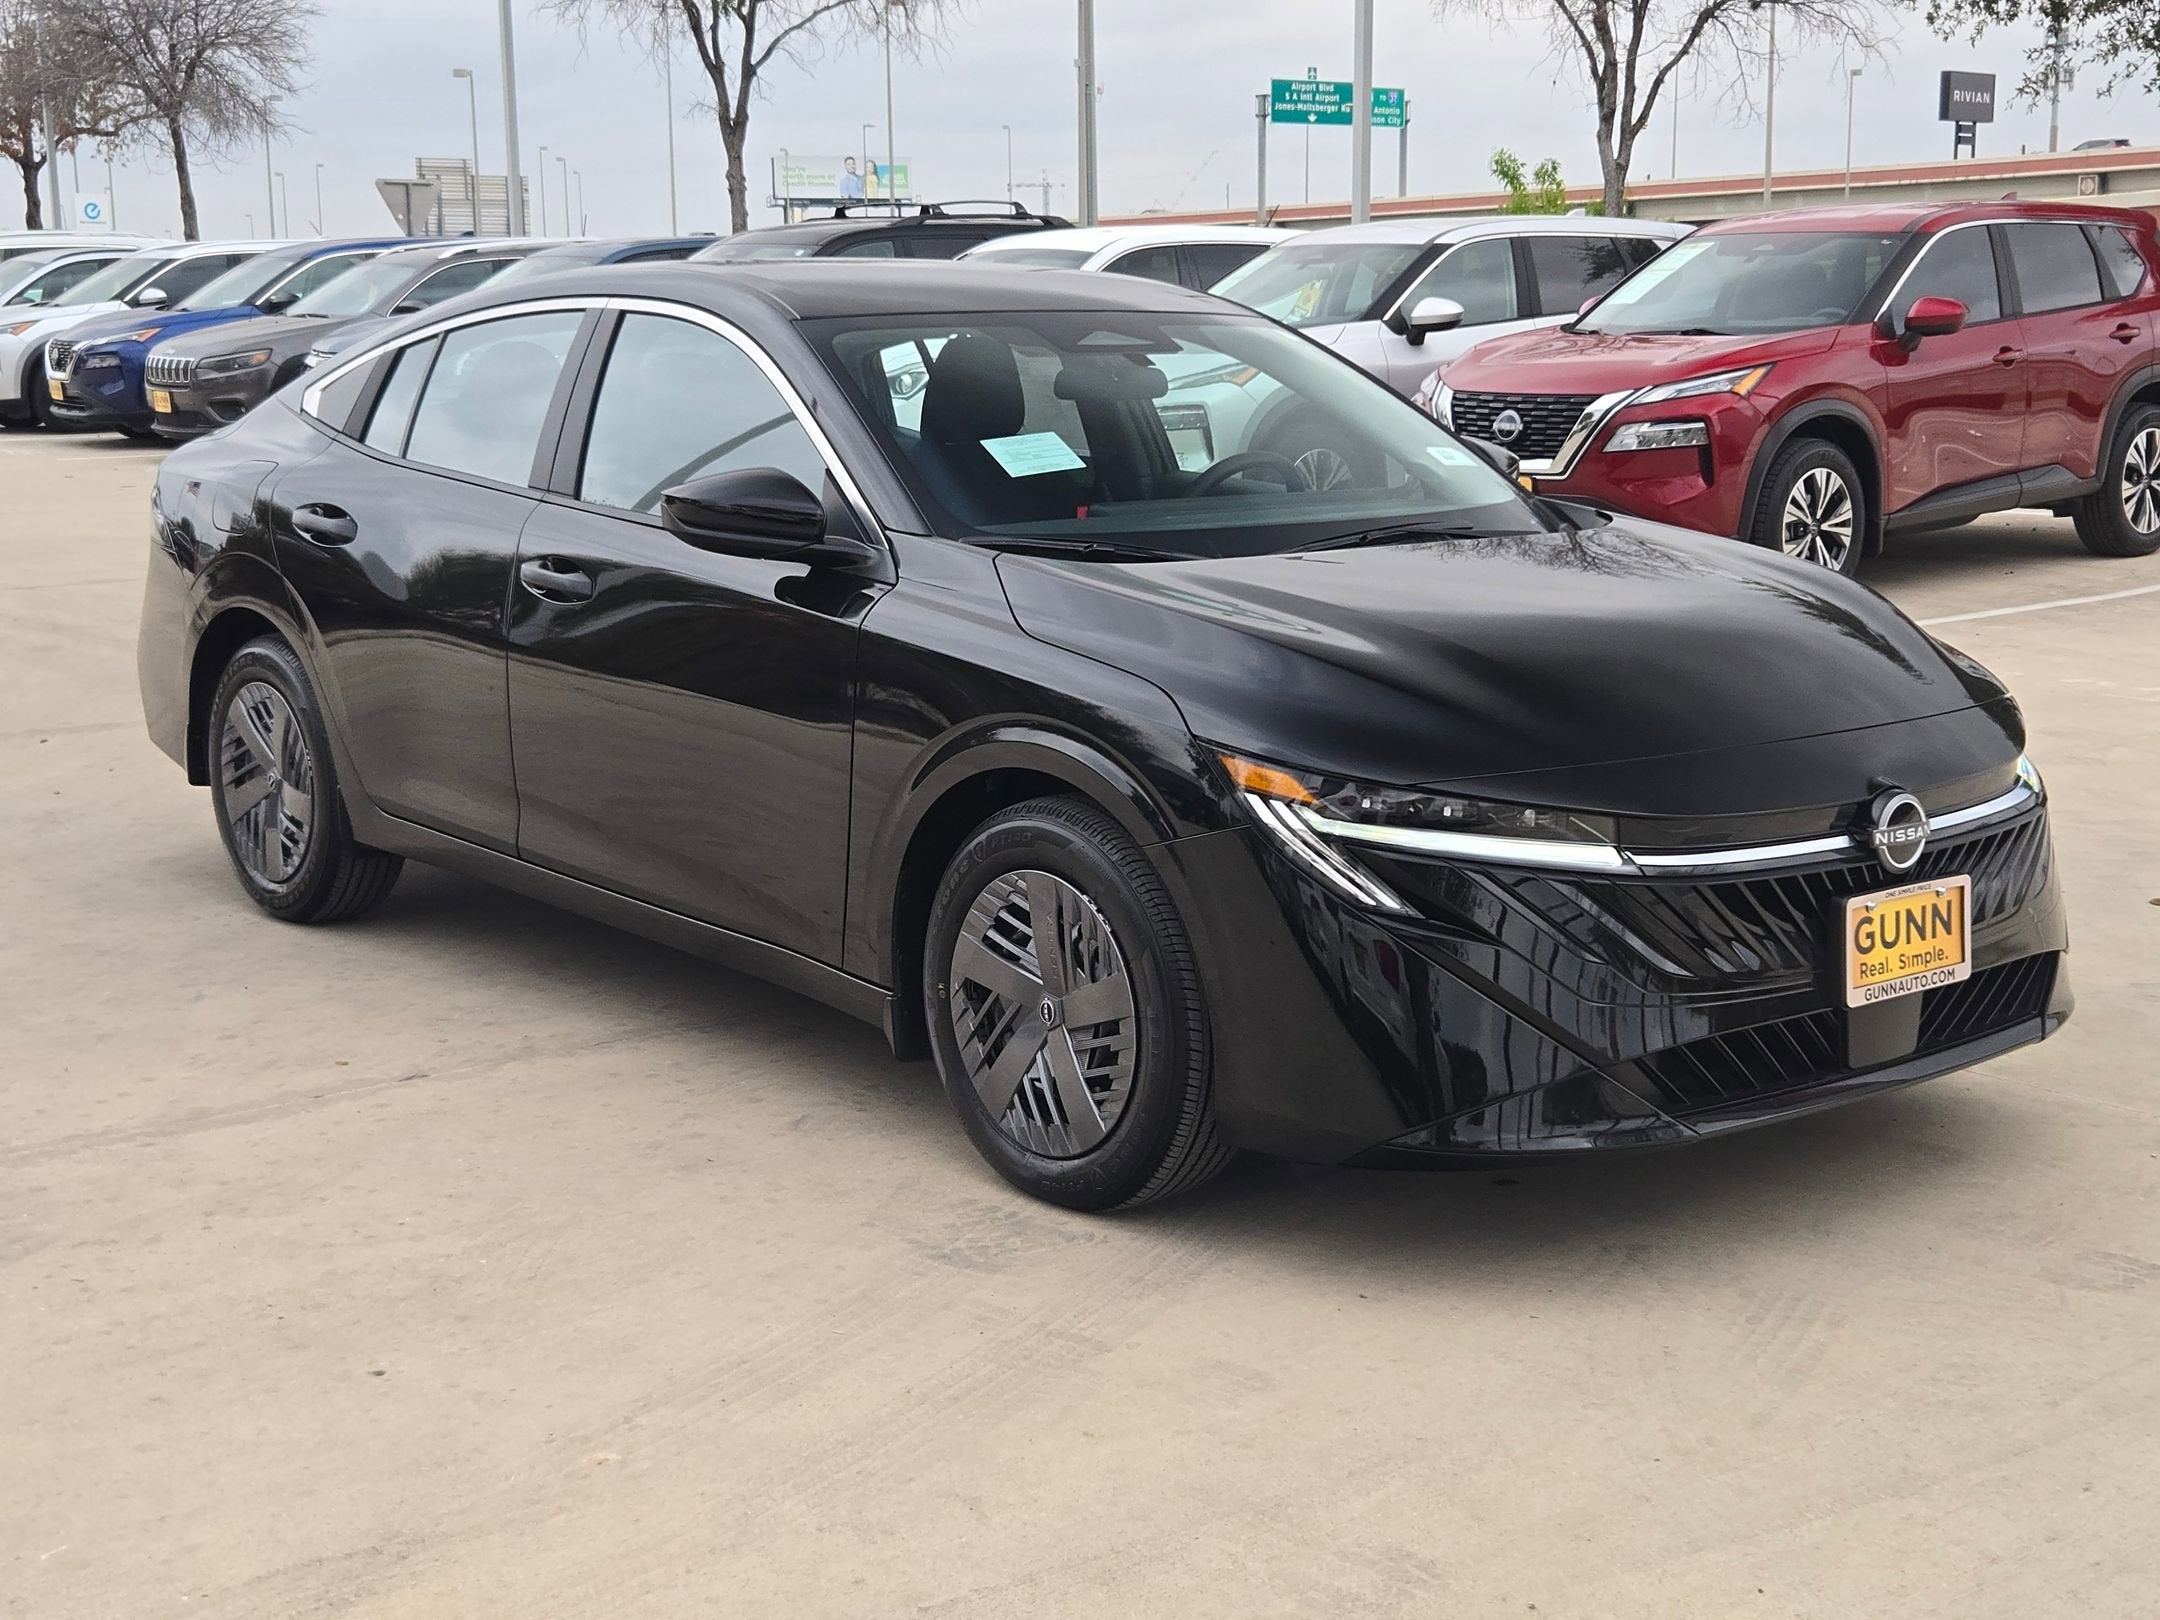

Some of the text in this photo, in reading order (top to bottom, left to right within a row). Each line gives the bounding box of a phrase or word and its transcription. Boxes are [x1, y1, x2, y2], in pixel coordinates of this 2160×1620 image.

[1291, 82, 1334, 92] Airport Blvd
[1292, 93, 1298, 101] A
[1315, 94, 1340, 103] Airport
[1953, 90, 1990, 104] RIVIAN
[1274, 102, 1338, 113] Jones-Maltsberger
[1373, 106, 1400, 115] Antonio
[1388, 116, 1400, 126] City
[1875, 825, 1930, 845] NISSAN
[1854, 899, 1952, 955] GUNN
[1860, 956, 1893, 979] Real.
[1864, 967, 1956, 1001] GUNNAUTO.COM
